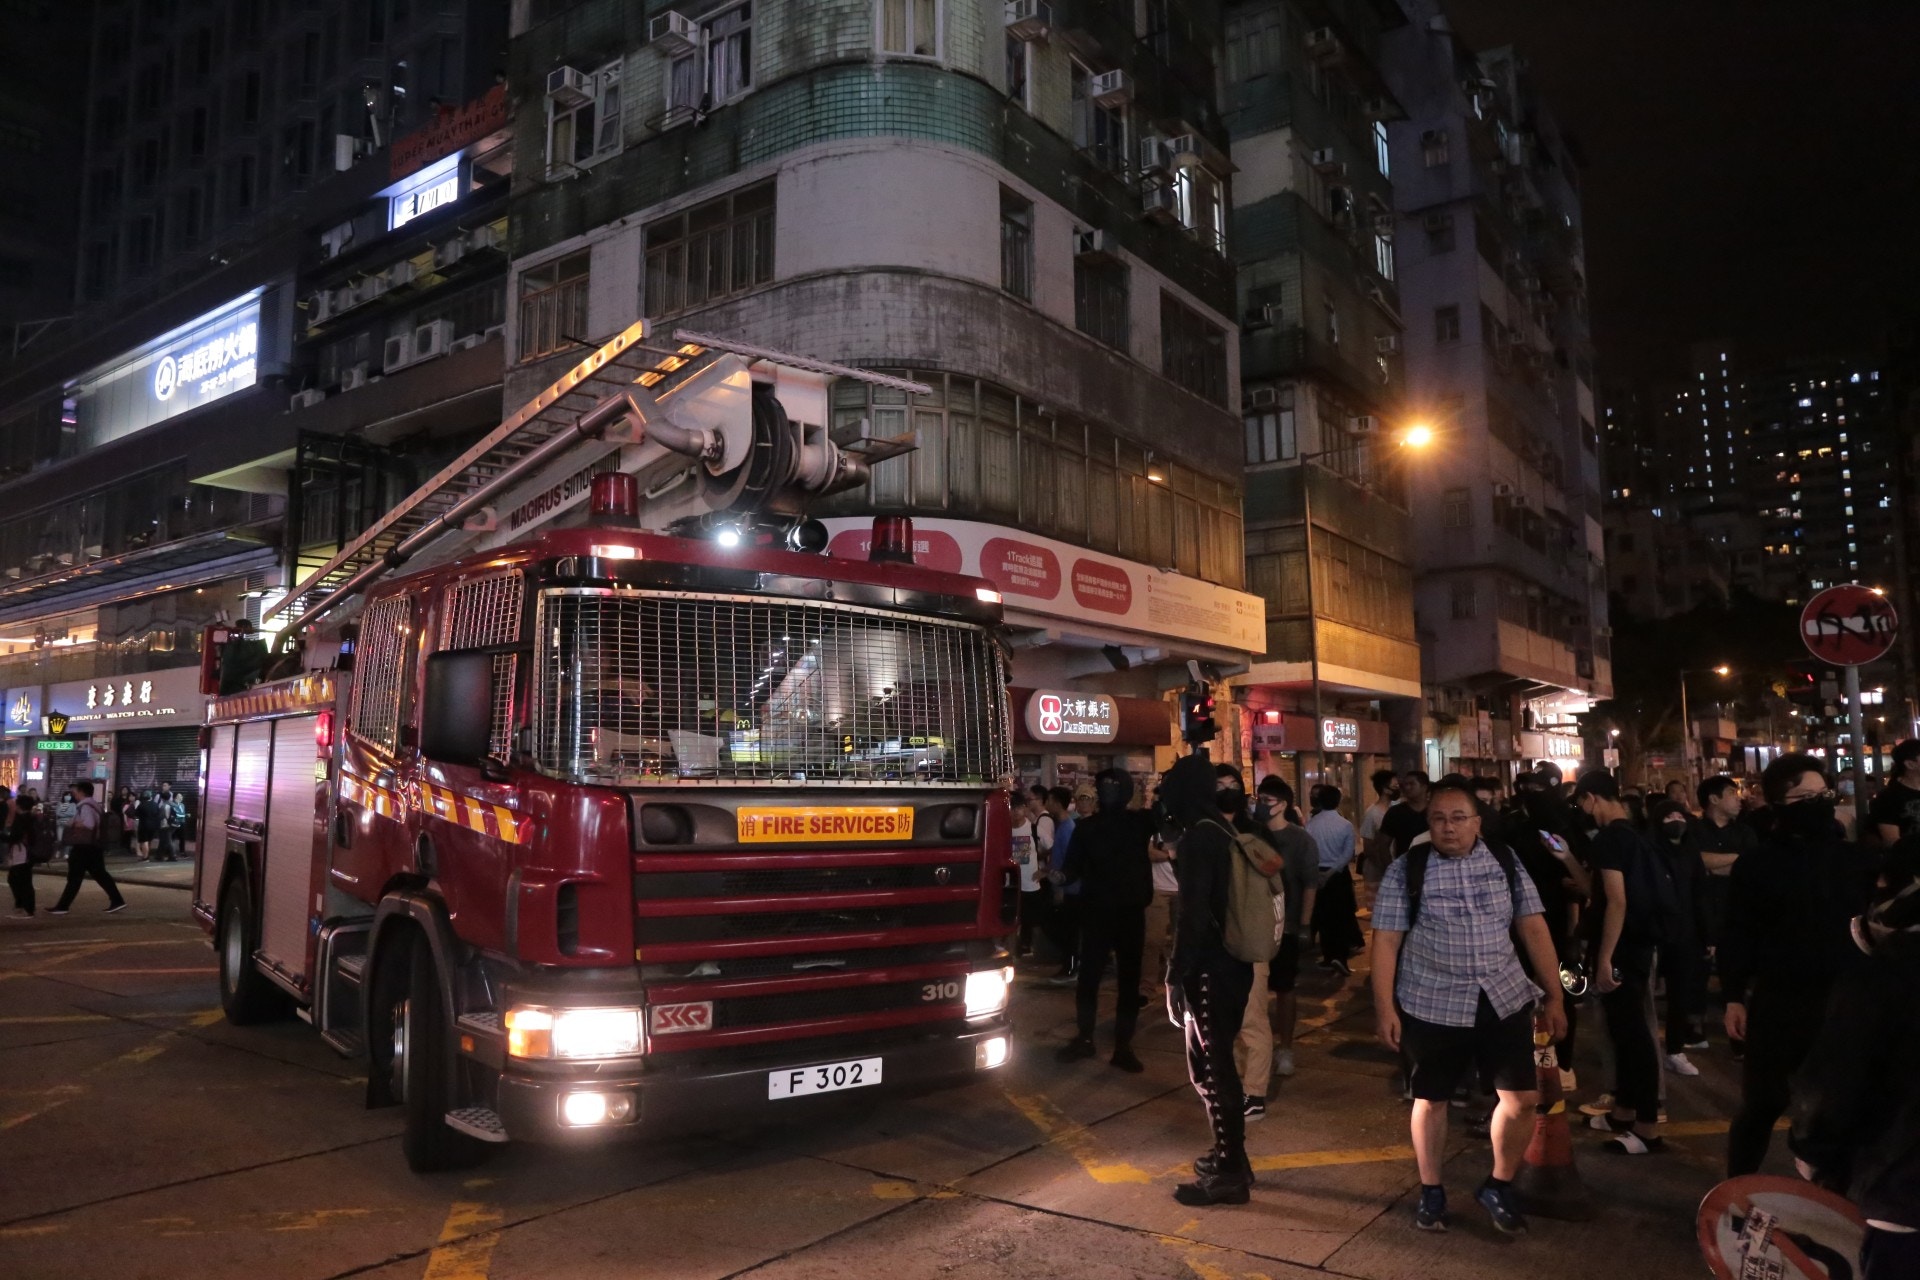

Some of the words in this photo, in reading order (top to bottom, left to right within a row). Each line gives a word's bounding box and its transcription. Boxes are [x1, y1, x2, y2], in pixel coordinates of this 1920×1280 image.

[510, 484, 562, 531] MAGIRUS
[106, 711, 135, 719] WATCH
[1063, 697, 1111, 719] 大新銀行
[38, 741, 73, 749] ROLEX
[740, 814, 756, 838] 消
[762, 816, 804, 835] FIRE
[809, 815, 895, 835] SERVICES
[897, 812, 911, 834] 防
[921, 982, 959, 1001] 310
[789, 1070, 805, 1094] F
[815, 1062, 863, 1090] 302
